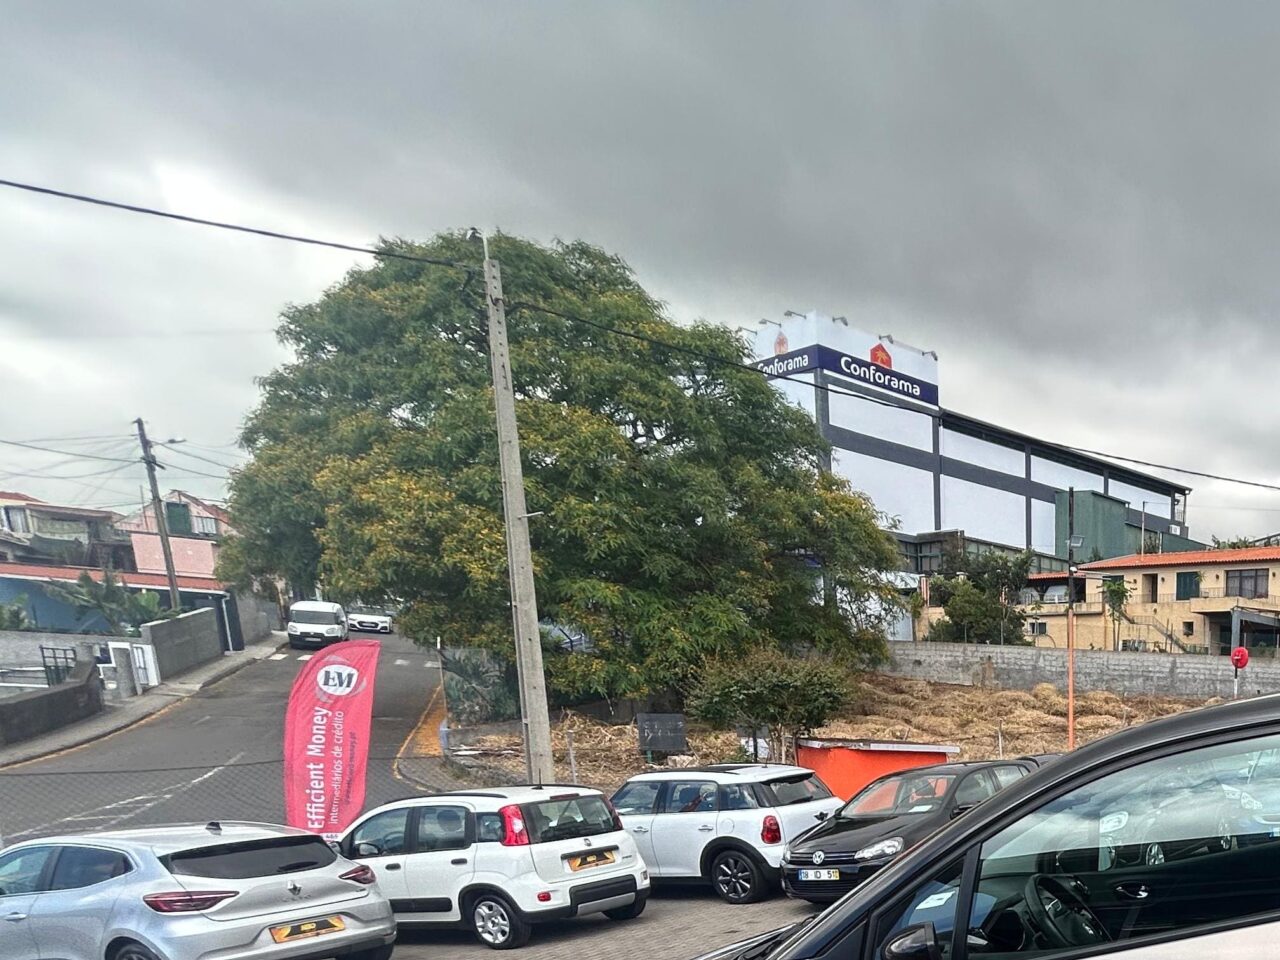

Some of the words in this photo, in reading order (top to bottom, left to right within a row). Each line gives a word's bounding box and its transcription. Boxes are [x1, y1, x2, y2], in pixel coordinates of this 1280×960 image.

[840, 356, 921, 396] Conforama
[322, 670, 355, 689] EM
[306, 706, 332, 757] Money
[332, 711, 344, 744] crédito
[332, 745, 343, 758] de
[305, 763, 325, 829] Efficient
[329, 760, 344, 824] intermediários
